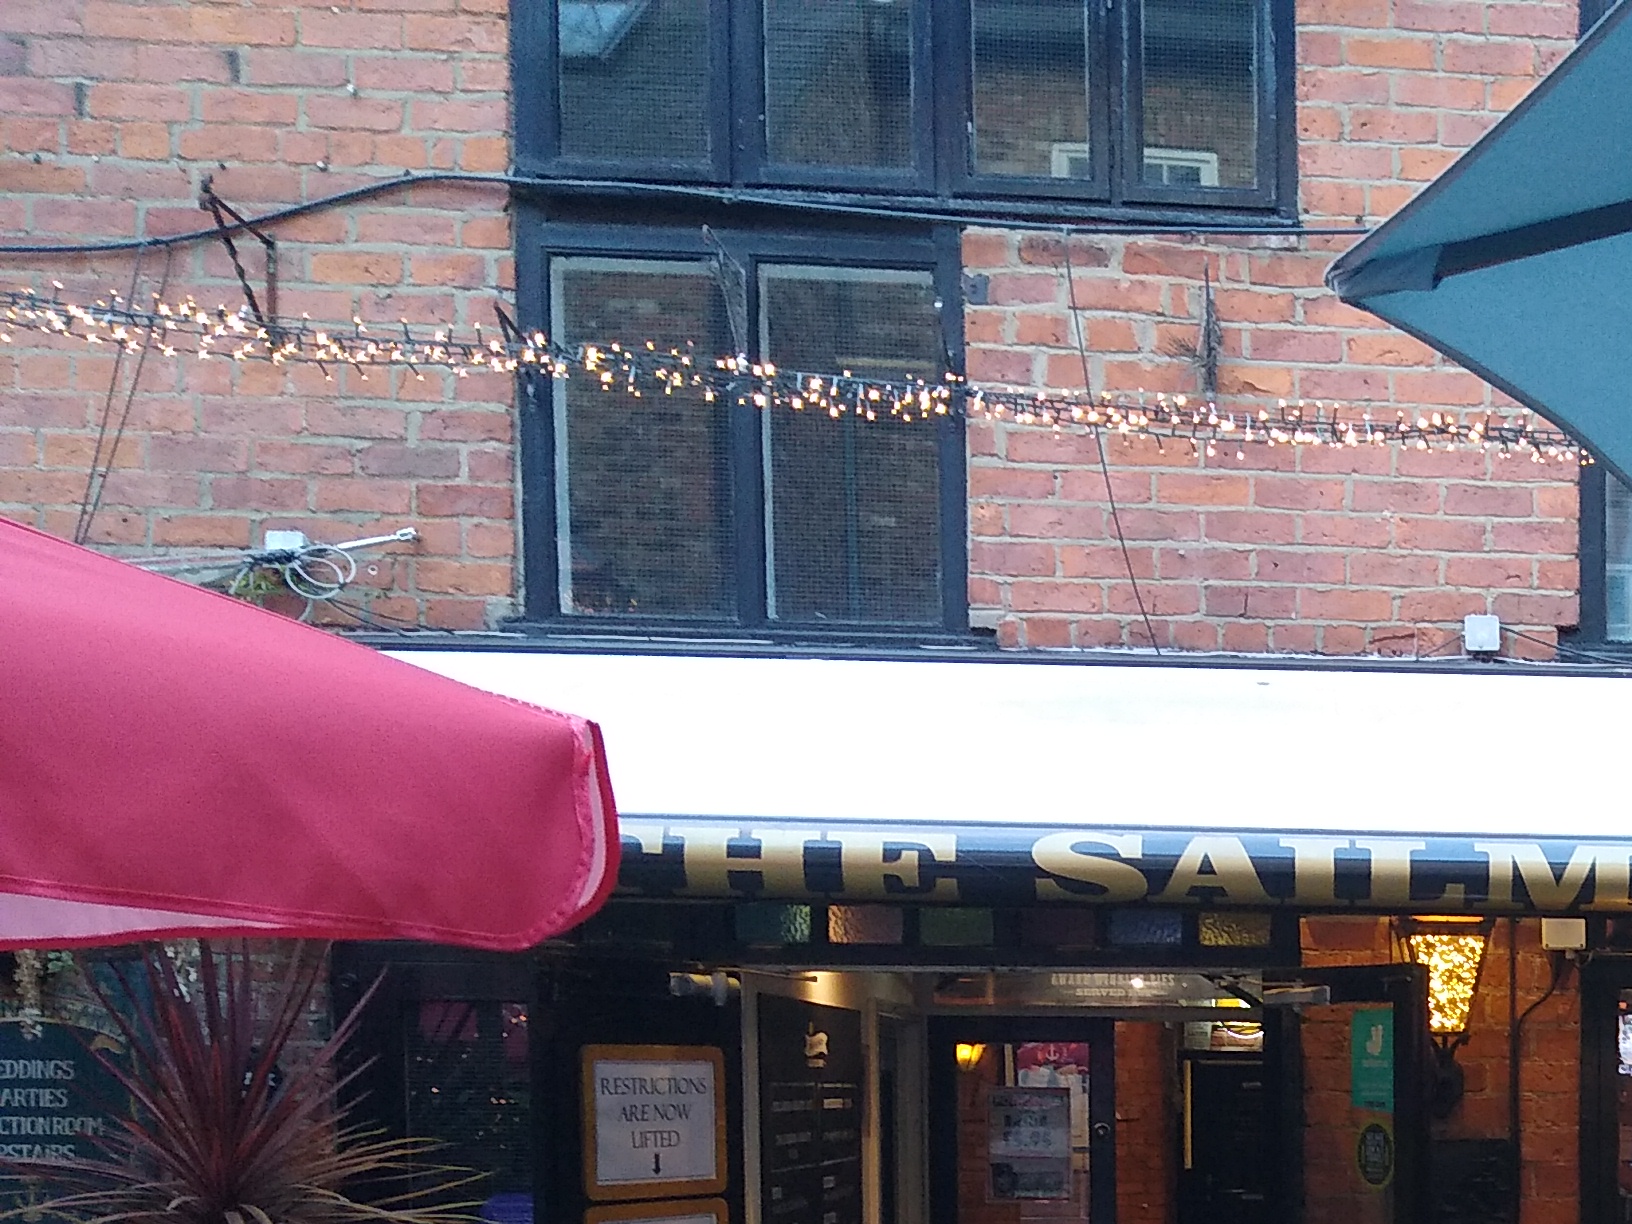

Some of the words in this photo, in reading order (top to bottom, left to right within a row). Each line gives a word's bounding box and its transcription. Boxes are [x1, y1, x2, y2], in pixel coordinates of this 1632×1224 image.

[1075, 988, 1126, 997] SERVED
[600, 1077, 707, 1095] RESTRICTIONS
[618, 1104, 650, 1122] ARE
[653, 1103, 692, 1121] NOW
[52, 1116, 103, 1136] ROOM
[631, 1130, 681, 1149] LIFTED
